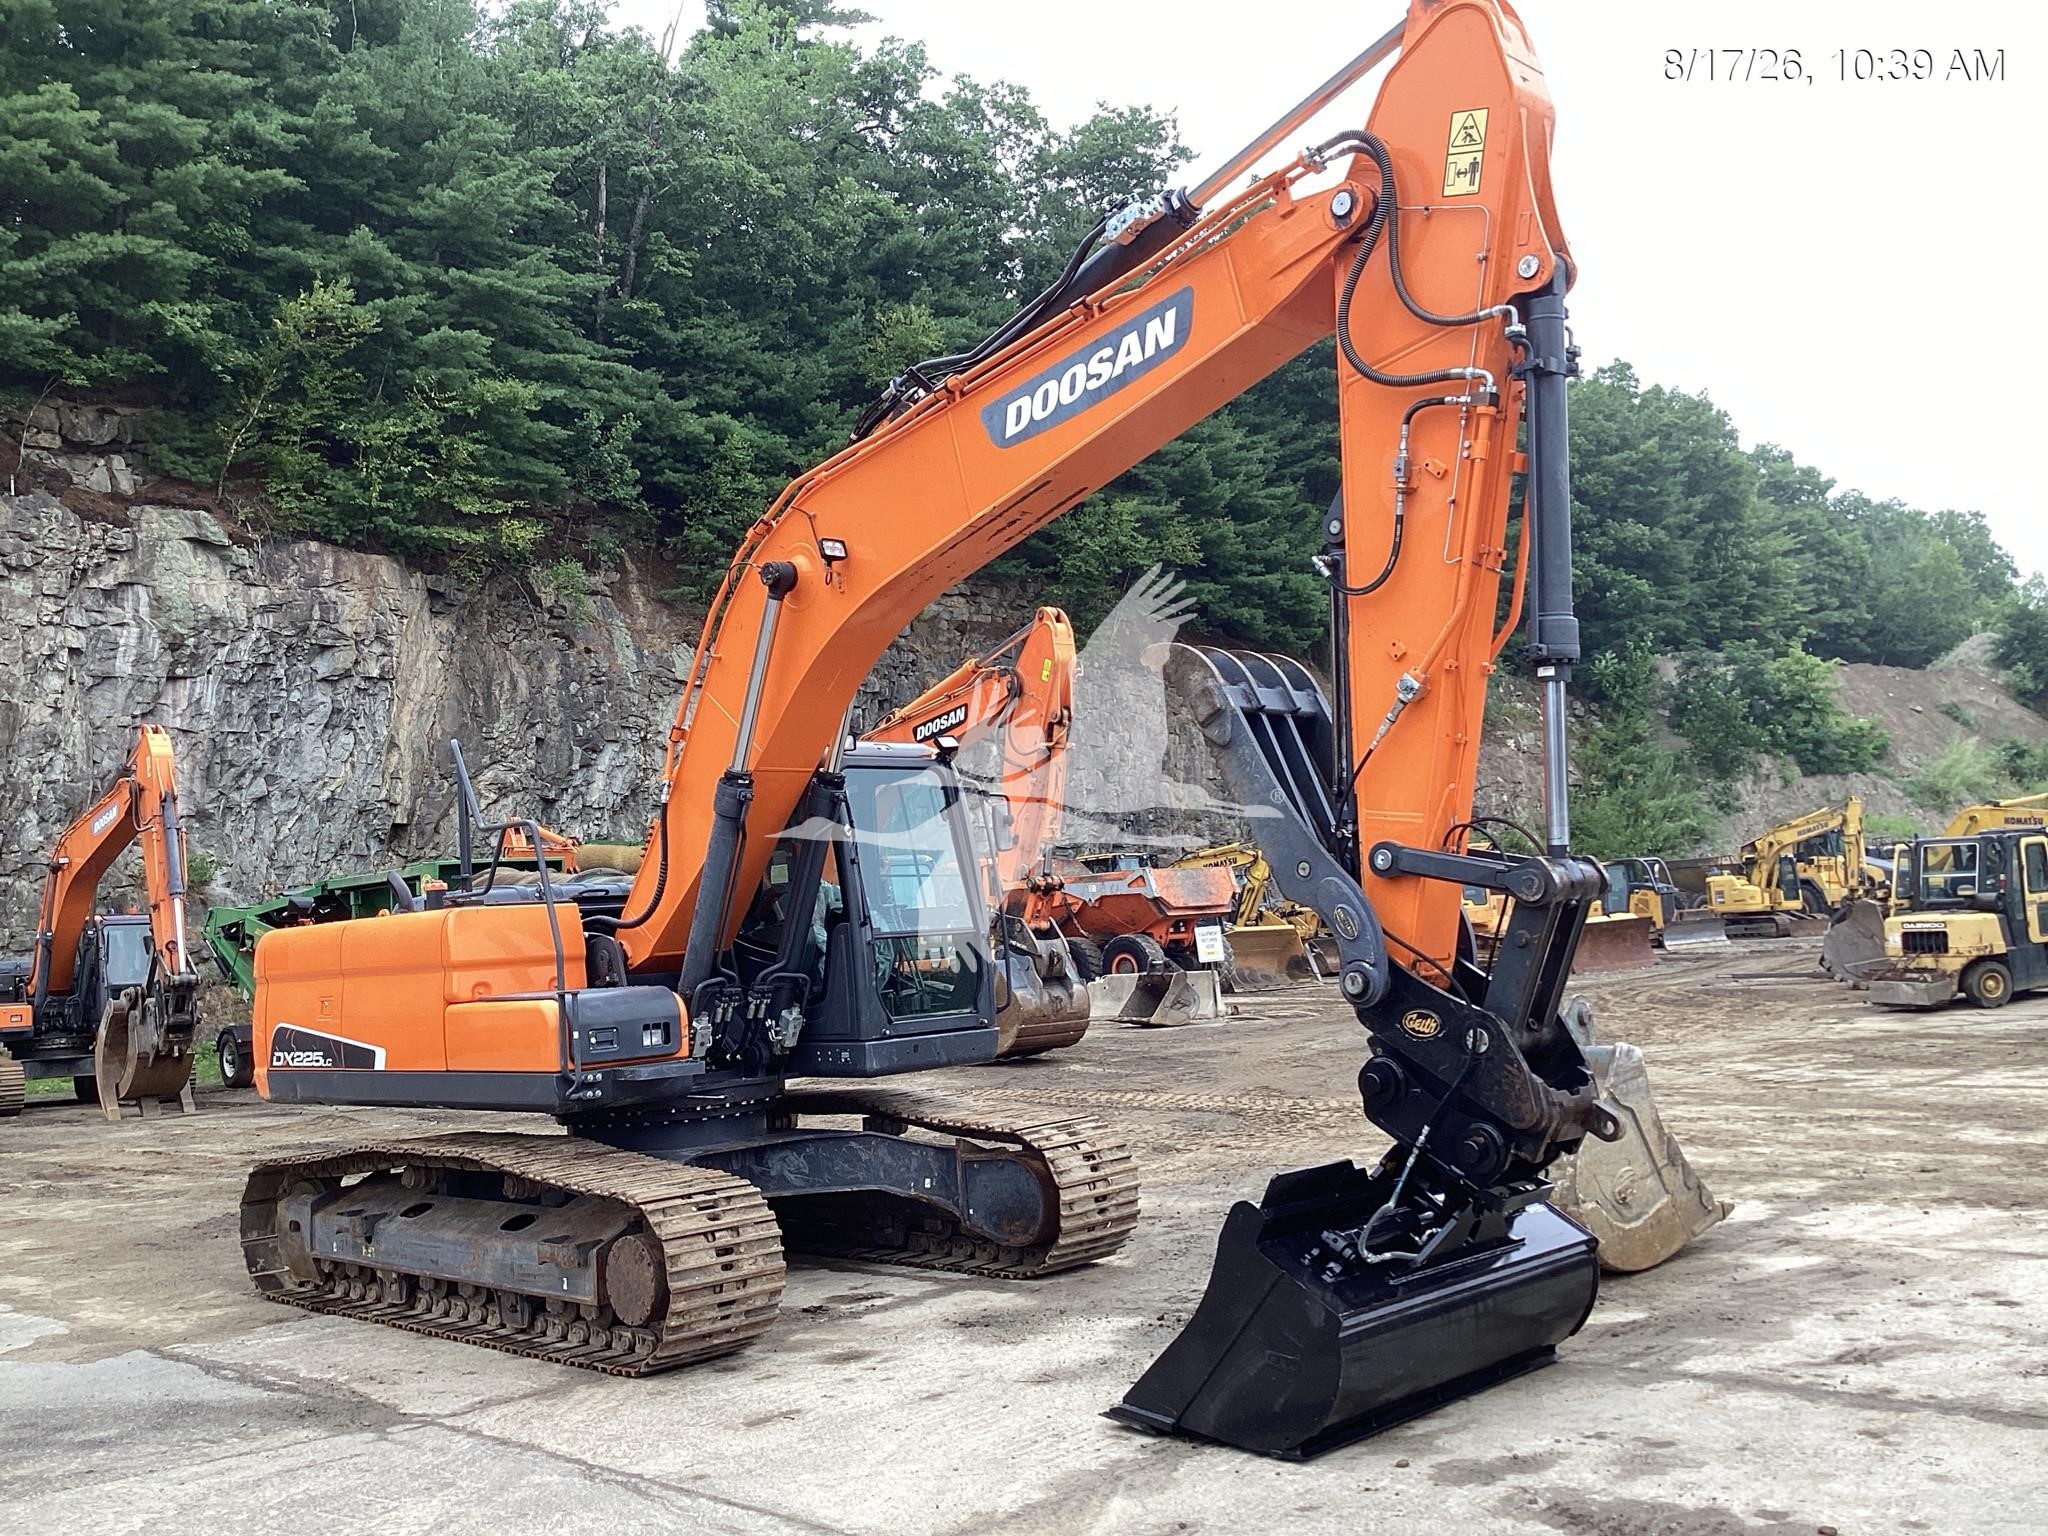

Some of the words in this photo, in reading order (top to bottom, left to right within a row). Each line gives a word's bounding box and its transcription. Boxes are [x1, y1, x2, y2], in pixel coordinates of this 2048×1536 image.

[1004, 306, 1177, 440] DOOSAN
[916, 705, 966, 741] DOOSAN
[1797, 821, 1829, 837] KOMATSU
[2004, 816, 2044, 826] KOMATSU
[1902, 922, 1946, 930] DAEWOO
